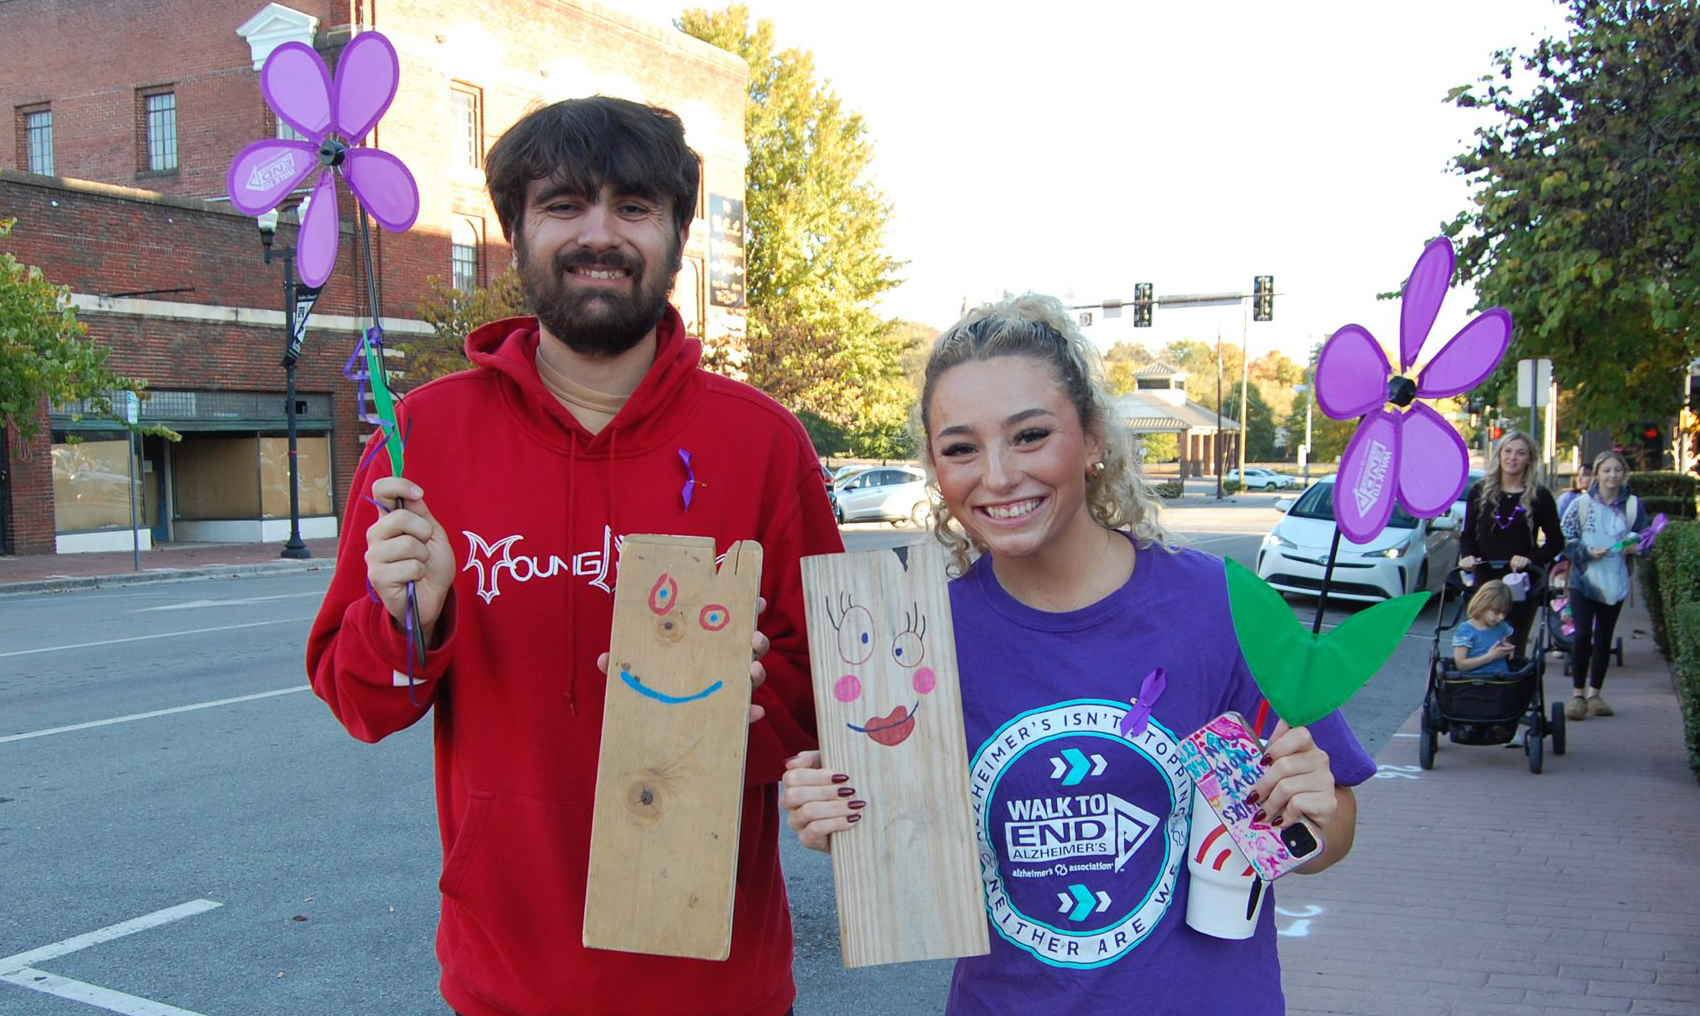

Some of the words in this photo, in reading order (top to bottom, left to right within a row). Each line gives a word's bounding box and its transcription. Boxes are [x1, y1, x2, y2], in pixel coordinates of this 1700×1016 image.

[261, 159, 292, 180] END
[1377, 450, 1392, 481] WALK
[1064, 712, 1121, 729] ISN'T
[1131, 730, 1188, 817] TOPPING
[1007, 796, 1073, 821] WALK
[1075, 794, 1106, 815] TO
[1011, 820, 1107, 847] END
[1013, 843, 1107, 859] ALZHEIMER'S
[1012, 868, 1054, 878] alzheimer's
[989, 879, 1079, 956] NEITHER
[1098, 918, 1146, 955] ARE
